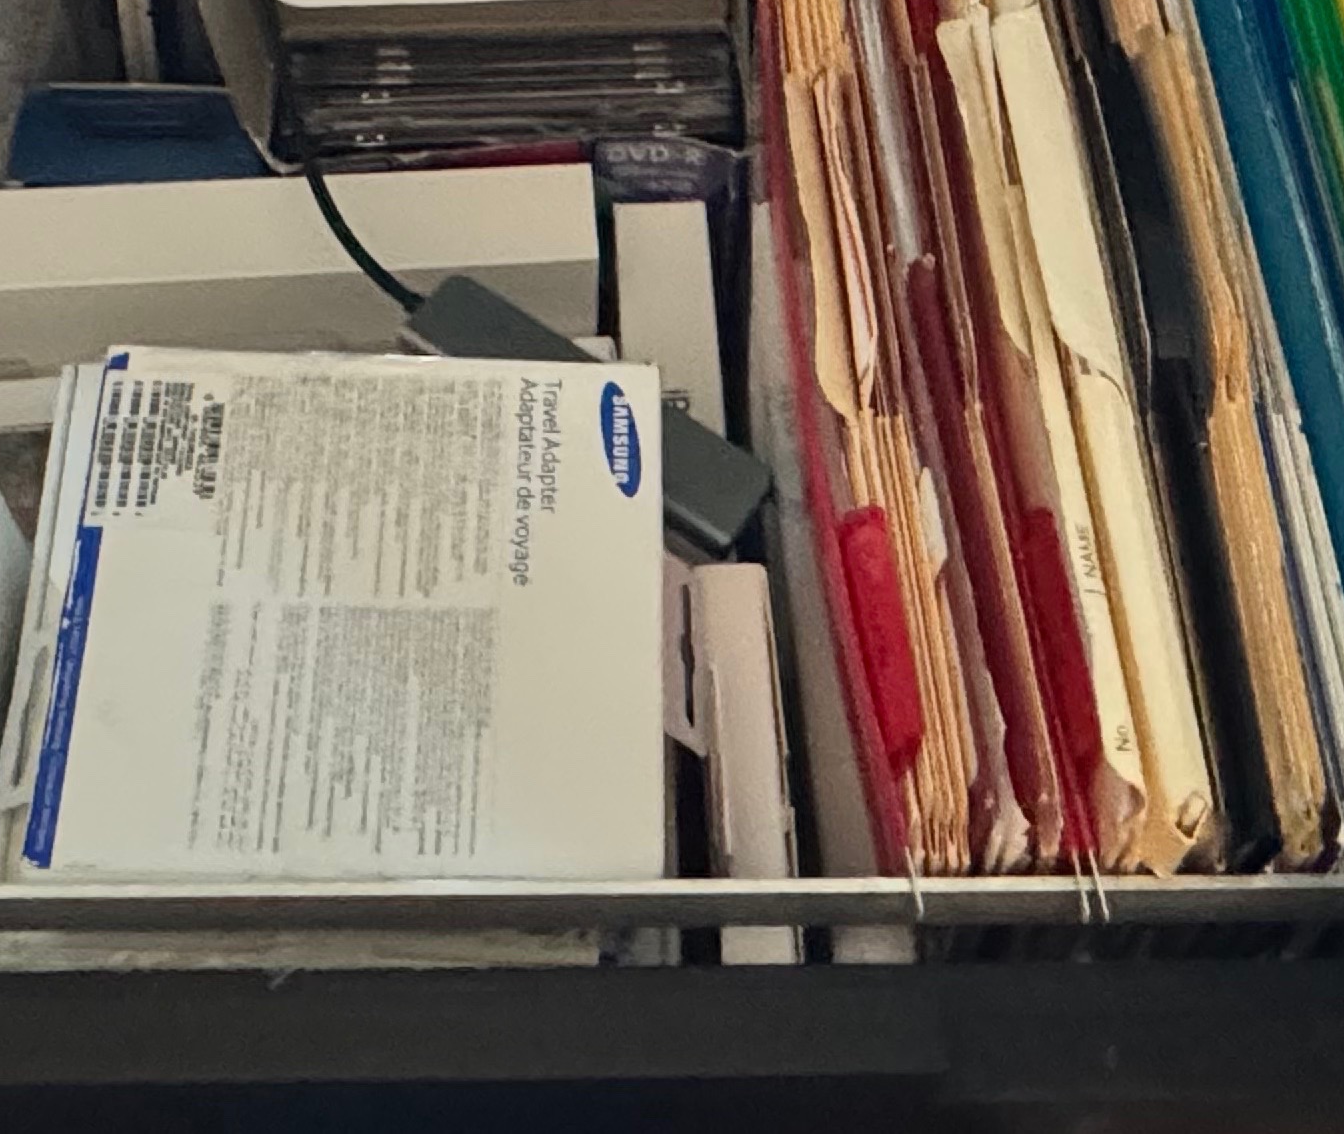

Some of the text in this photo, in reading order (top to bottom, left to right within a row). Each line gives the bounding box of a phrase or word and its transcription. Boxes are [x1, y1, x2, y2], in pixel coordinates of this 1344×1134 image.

[508, 376, 539, 587] Adaptateur de voyage
[537, 378, 563, 514] Travel Adapter
[611, 393, 631, 485] SAMSUNG
